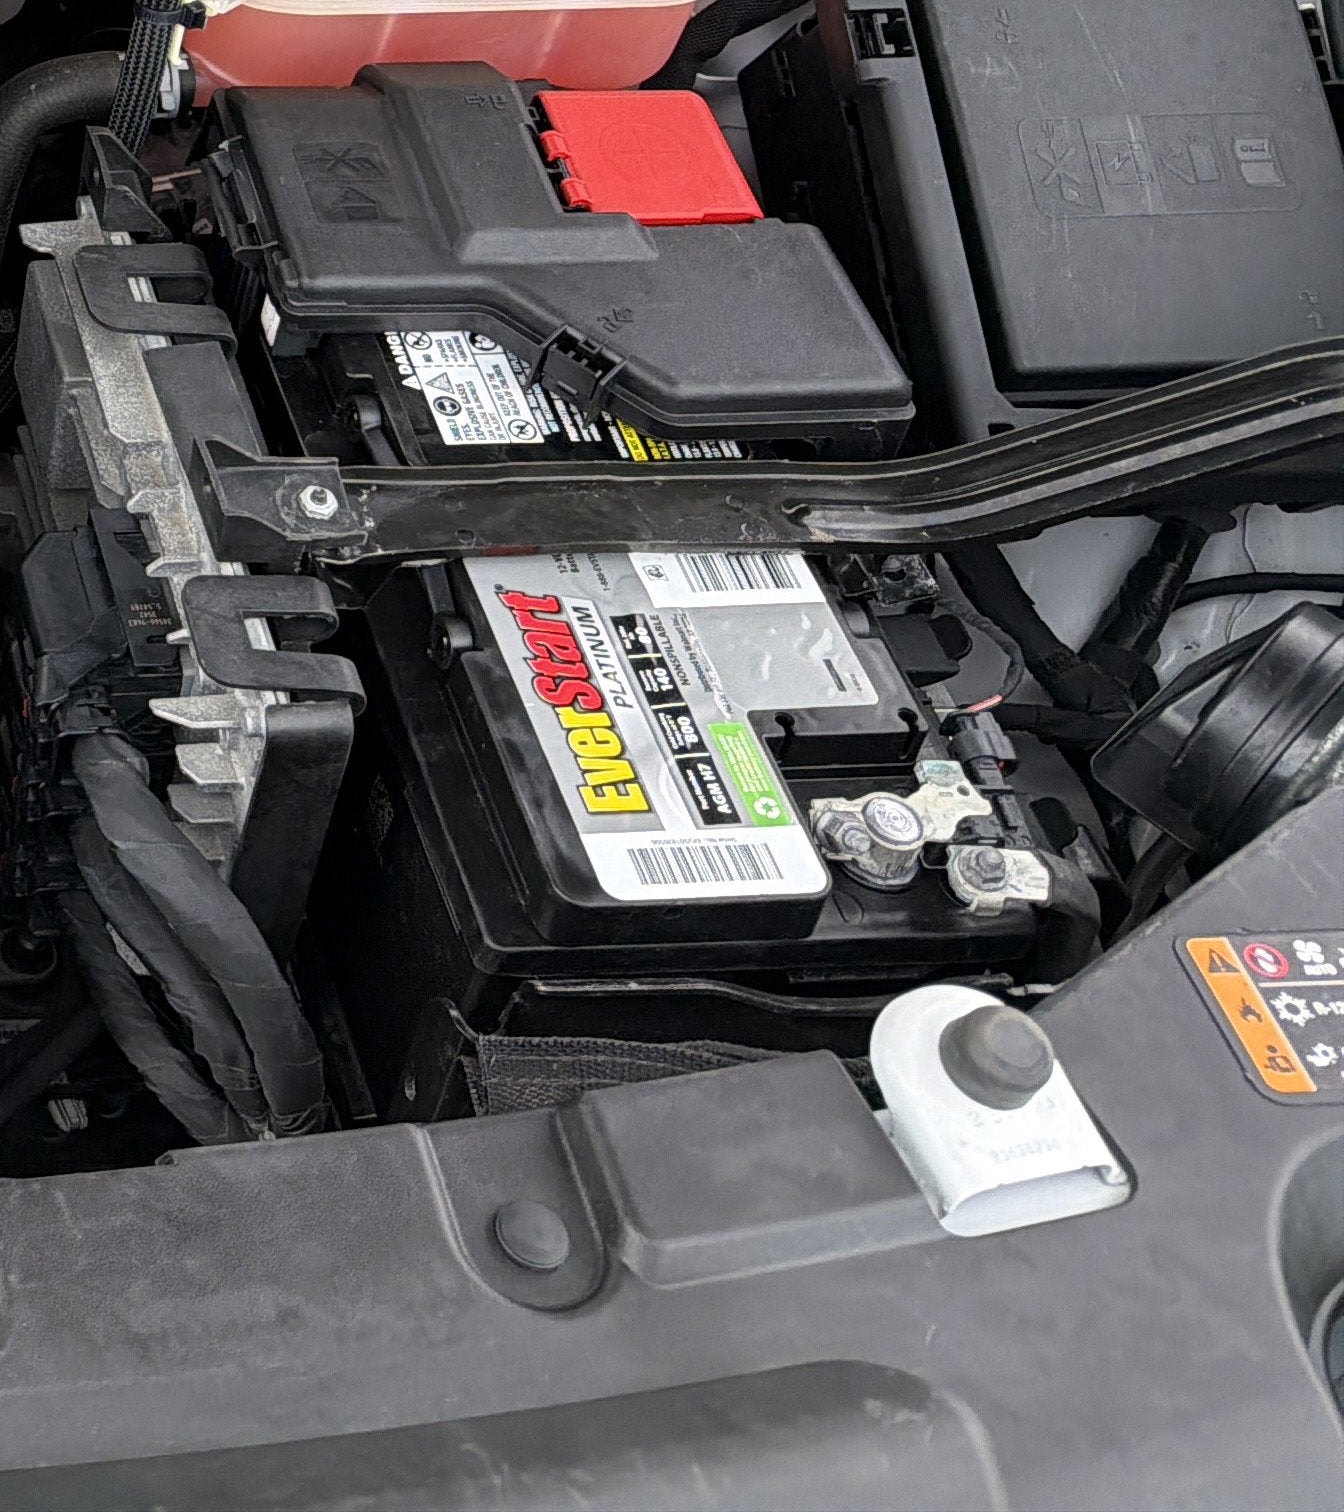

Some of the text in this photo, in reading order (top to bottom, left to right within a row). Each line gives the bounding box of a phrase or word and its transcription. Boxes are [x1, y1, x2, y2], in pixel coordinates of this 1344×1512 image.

[384, 331, 412, 375] DANG
[570, 605, 634, 708] PLATINUM
[648, 614, 691, 685] NONSPILLABLE
[495, 589, 652, 815] EverStart
[652, 667, 676, 691] 140
[674, 715, 699, 743] 800
[696, 762, 732, 813] AGM H7
